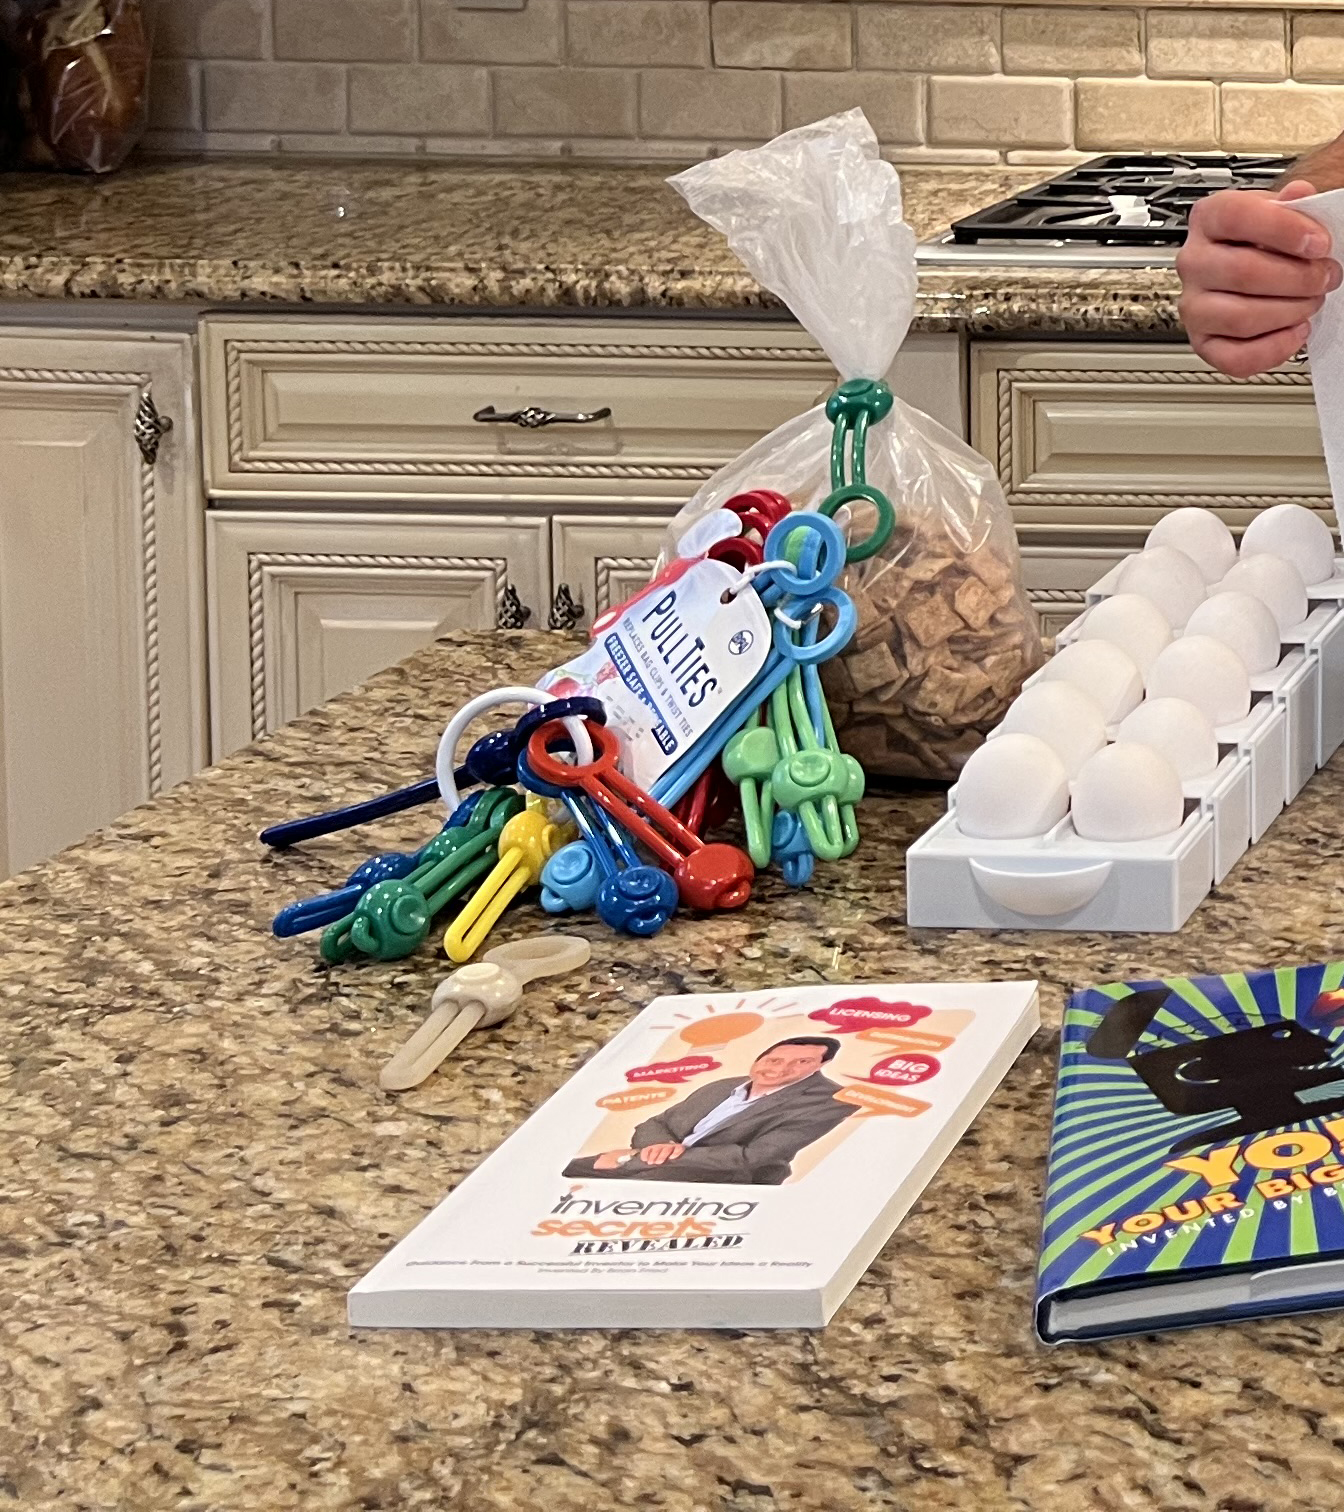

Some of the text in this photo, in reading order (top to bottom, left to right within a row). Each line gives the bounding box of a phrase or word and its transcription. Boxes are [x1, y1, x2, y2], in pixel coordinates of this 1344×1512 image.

[641, 647, 654, 669] BAG
[665, 694, 682, 719] TWIST
[679, 717, 693, 737] TIES
[829, 1007, 912, 1022] LICENSING
[633, 1062, 709, 1078] MARKETING
[875, 1068, 921, 1082] IDEAS
[888, 1059, 929, 1074] BIG
[550, 1188, 759, 1221] inventing
[531, 1217, 717, 1239] secrets
[1079, 1192, 1245, 1248] YOUR
[1106, 1208, 1255, 1256] INVENTED
[1273, 1194, 1304, 1211] BY
[569, 1234, 750, 1255] REVEALED
